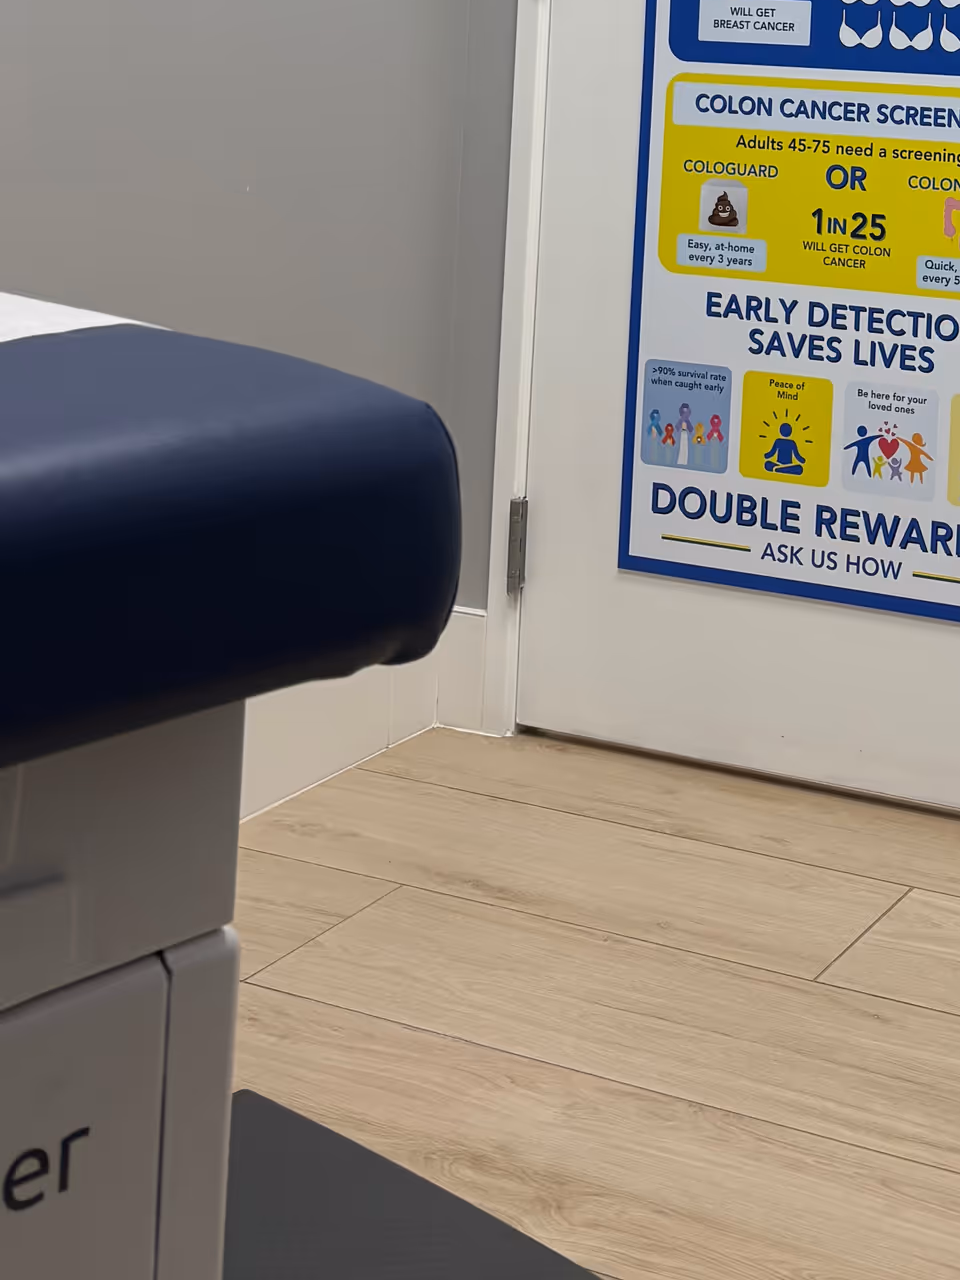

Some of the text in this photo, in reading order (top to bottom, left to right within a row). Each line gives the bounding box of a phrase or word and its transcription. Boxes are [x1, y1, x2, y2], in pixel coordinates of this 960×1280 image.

[730, 7, 776, 18] WILL GET
[713, 19, 795, 32] BREAST CANCER
[695, 94, 773, 117] COLON
[779, 98, 870, 122] CANCER
[736, 135, 783, 151] Adults
[788, 138, 831, 154] 45-75
[836, 142, 873, 157] need
[879, 147, 887, 158] a
[684, 159, 778, 178] COLOGUARD
[825, 164, 867, 191] OR
[811, 208, 886, 241] 1 IN 25
[687, 239, 755, 254] Easy, at-home
[803, 241, 891, 257] WILL GET COLON
[689, 252, 753, 268] every 3 years
[823, 256, 866, 269] CANCER
[924, 260, 959, 274] Quick,
[922, 273, 951, 286] every
[706, 292, 798, 324] EARLY
[748, 329, 935, 374] SAVES LIVES
[652, 366, 727, 382] >90% survival rate
[651, 378, 724, 394] when caught early
[769, 379, 805, 391] Peace of
[777, 390, 798, 401] Mind
[857, 389, 927, 406] Be here for your
[868, 401, 915, 415] loved ones
[651, 483, 800, 534] DOUBLE
[761, 544, 902, 580] ASK US HOW
